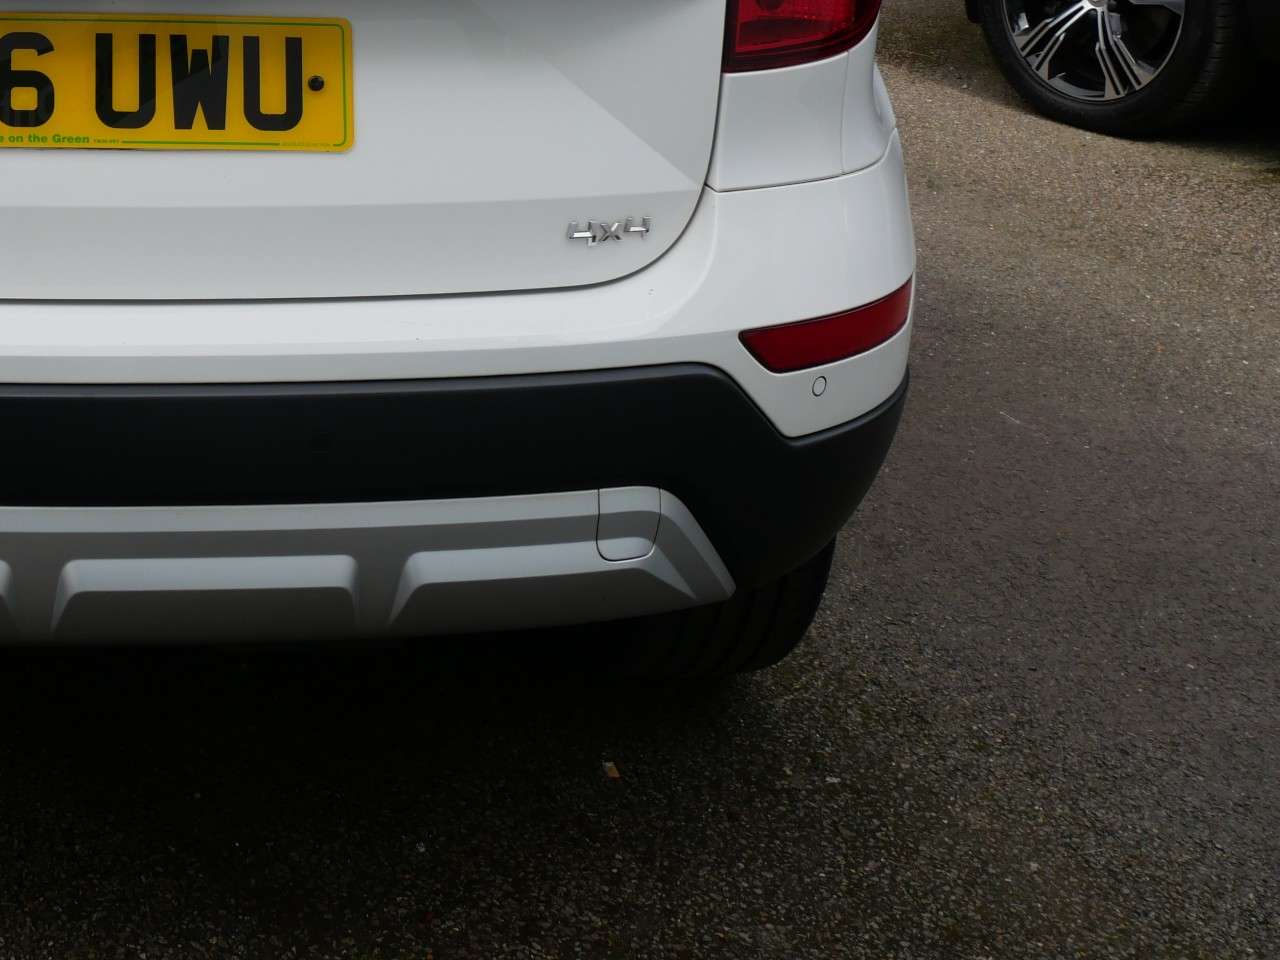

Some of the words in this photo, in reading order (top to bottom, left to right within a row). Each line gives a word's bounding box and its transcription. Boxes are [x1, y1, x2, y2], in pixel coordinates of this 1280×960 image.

[94, 33, 304, 132] UWU
[7, 134, 23, 144] on
[27, 133, 49, 144] the
[51, 134, 90, 144] Green
